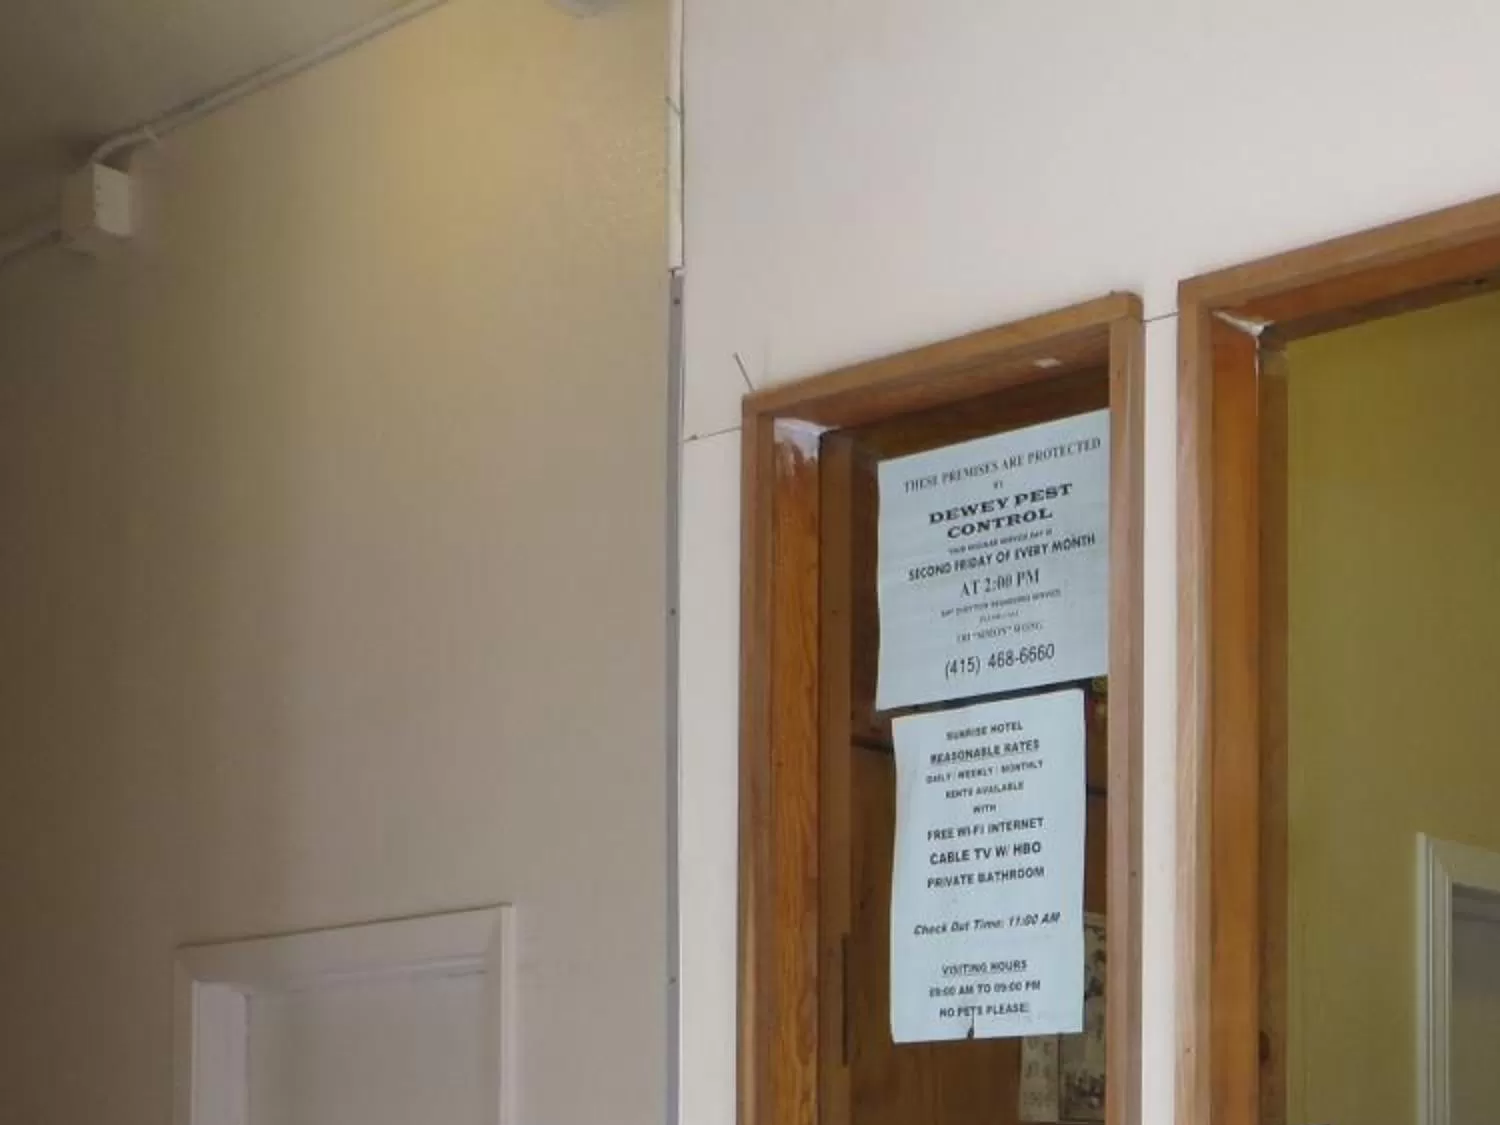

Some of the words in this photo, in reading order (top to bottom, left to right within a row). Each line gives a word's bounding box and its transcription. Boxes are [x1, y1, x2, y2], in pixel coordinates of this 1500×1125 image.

[905, 476, 938, 493] THESE
[942, 461, 999, 483] PREMISES
[1002, 454, 1024, 471] ARE
[1028, 436, 1101, 464] PROTECTED
[929, 496, 1009, 525] DEWEY
[1014, 483, 1073, 507] PEST
[947, 508, 1053, 539] CONTROL
[908, 562, 952, 581] SECOND
[955, 554, 993, 572] FRIDAY
[996, 551, 1010, 563] OF
[1015, 543, 1048, 561] EVERY
[1052, 532, 1096, 553] MONTH
[961, 579, 980, 597] AT
[985, 573, 1013, 593] 2:00
[1017, 567, 1040, 588] PM
[945, 656, 981, 680] (415)
[988, 643, 1056, 669] 468-6660
[946, 726, 988, 741] SUNRISE
[990, 721, 1023, 734] HOTEL
[930, 745, 1001, 764] REASONABLE
[1004, 738, 1040, 753] RATES
[958, 767, 994, 780] WEEKLY
[1001, 760, 1043, 774] MONTHLY
[976, 781, 1024, 796] AVAILABLE
[973, 804, 996, 815] WITH
[927, 828, 955, 841] FREE
[988, 817, 1044, 835] INTERNET
[930, 849, 971, 865] CABLE
[974, 847, 993, 860] TV
[1013, 841, 1042, 857] HBO
[927, 873, 974, 889] PRIVATE
[977, 866, 1045, 884] BATHROOM
[914, 923, 947, 935] Check
[951, 921, 970, 932] Out
[1040, 911, 1061, 925] AM
[942, 962, 988, 976] VISITING
[990, 959, 1027, 973] HOURS
[959, 984, 975, 995] AM
[977, 983, 992, 994] TO
[1025, 979, 1041, 991] PM
[940, 1007, 955, 1018] NO
[957, 1005, 983, 1017] PETS
